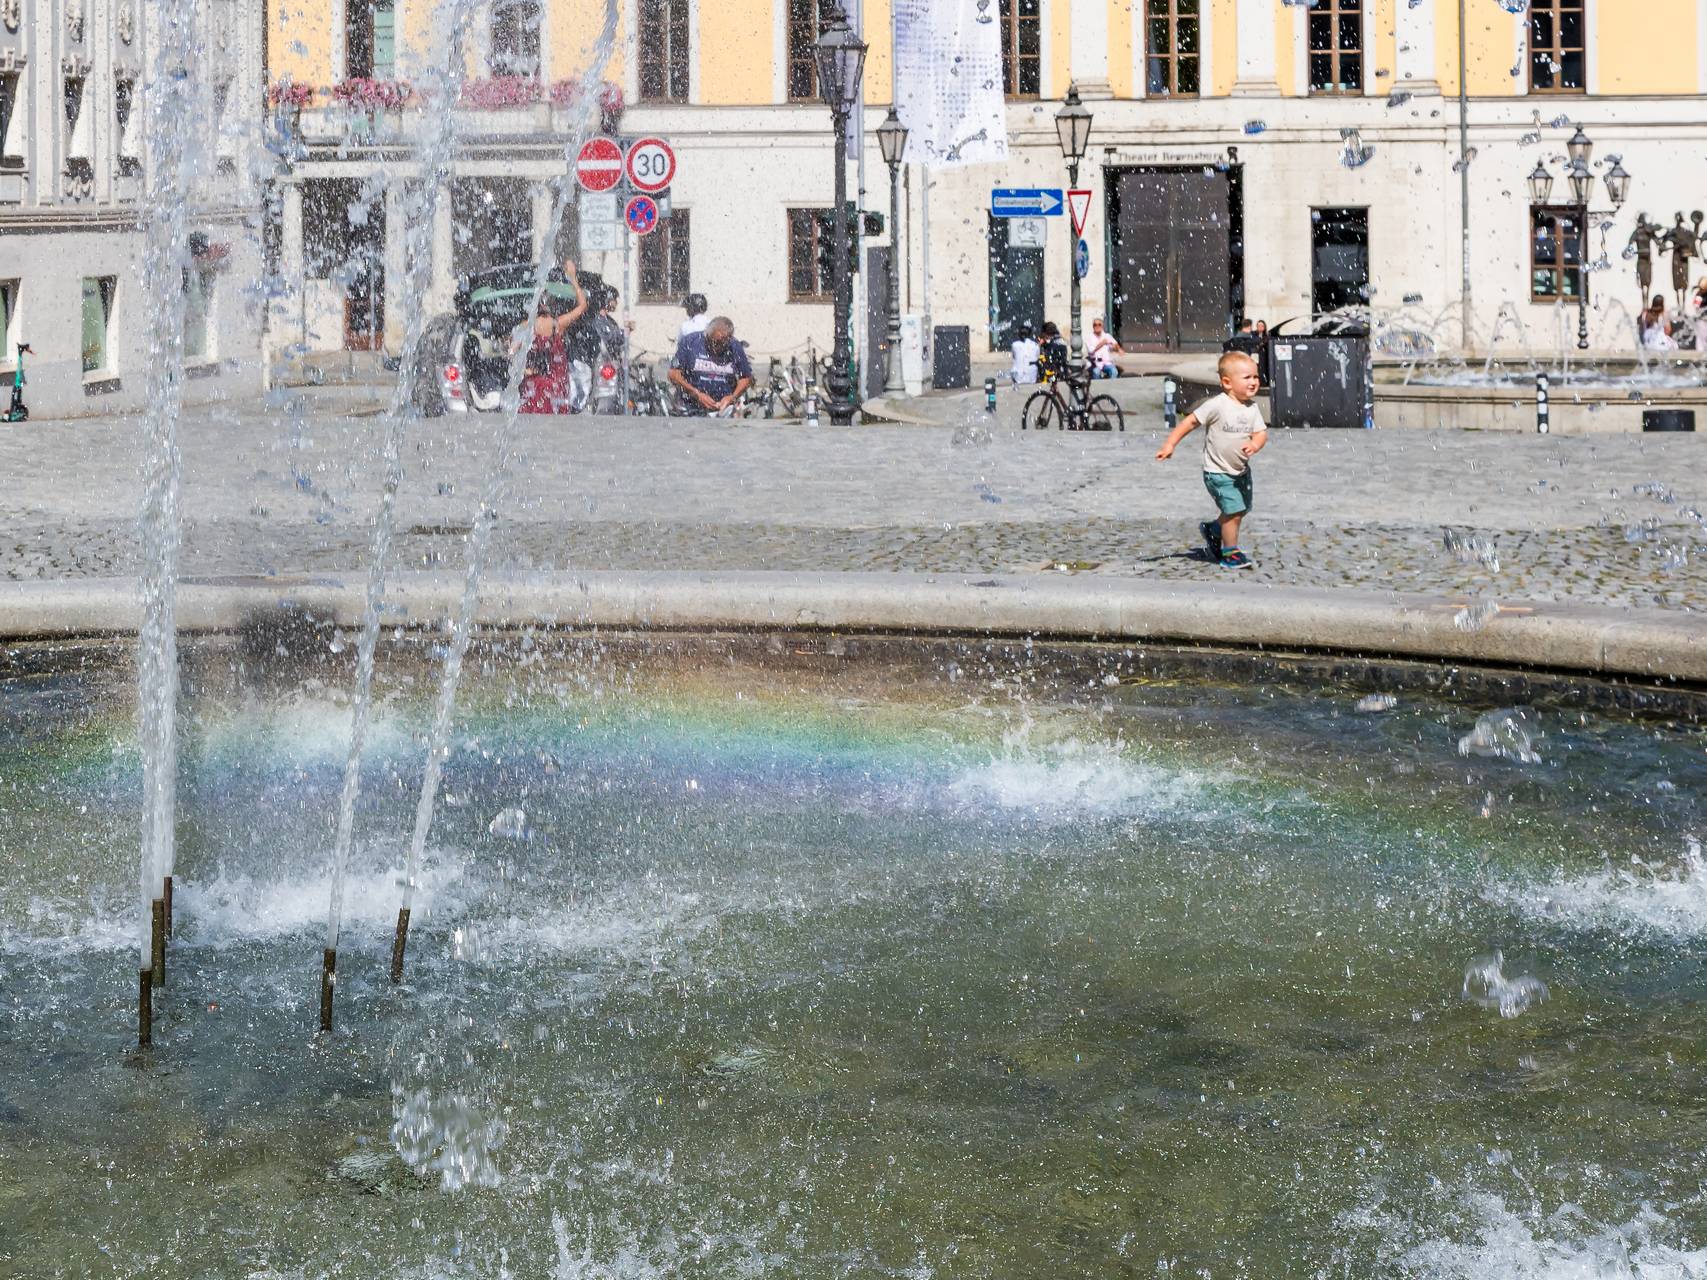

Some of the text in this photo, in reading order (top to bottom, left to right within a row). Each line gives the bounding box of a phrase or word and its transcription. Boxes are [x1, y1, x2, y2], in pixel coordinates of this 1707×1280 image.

[637, 153, 665, 176] 30
[1119, 150, 1223, 163] Theater Regensburg
